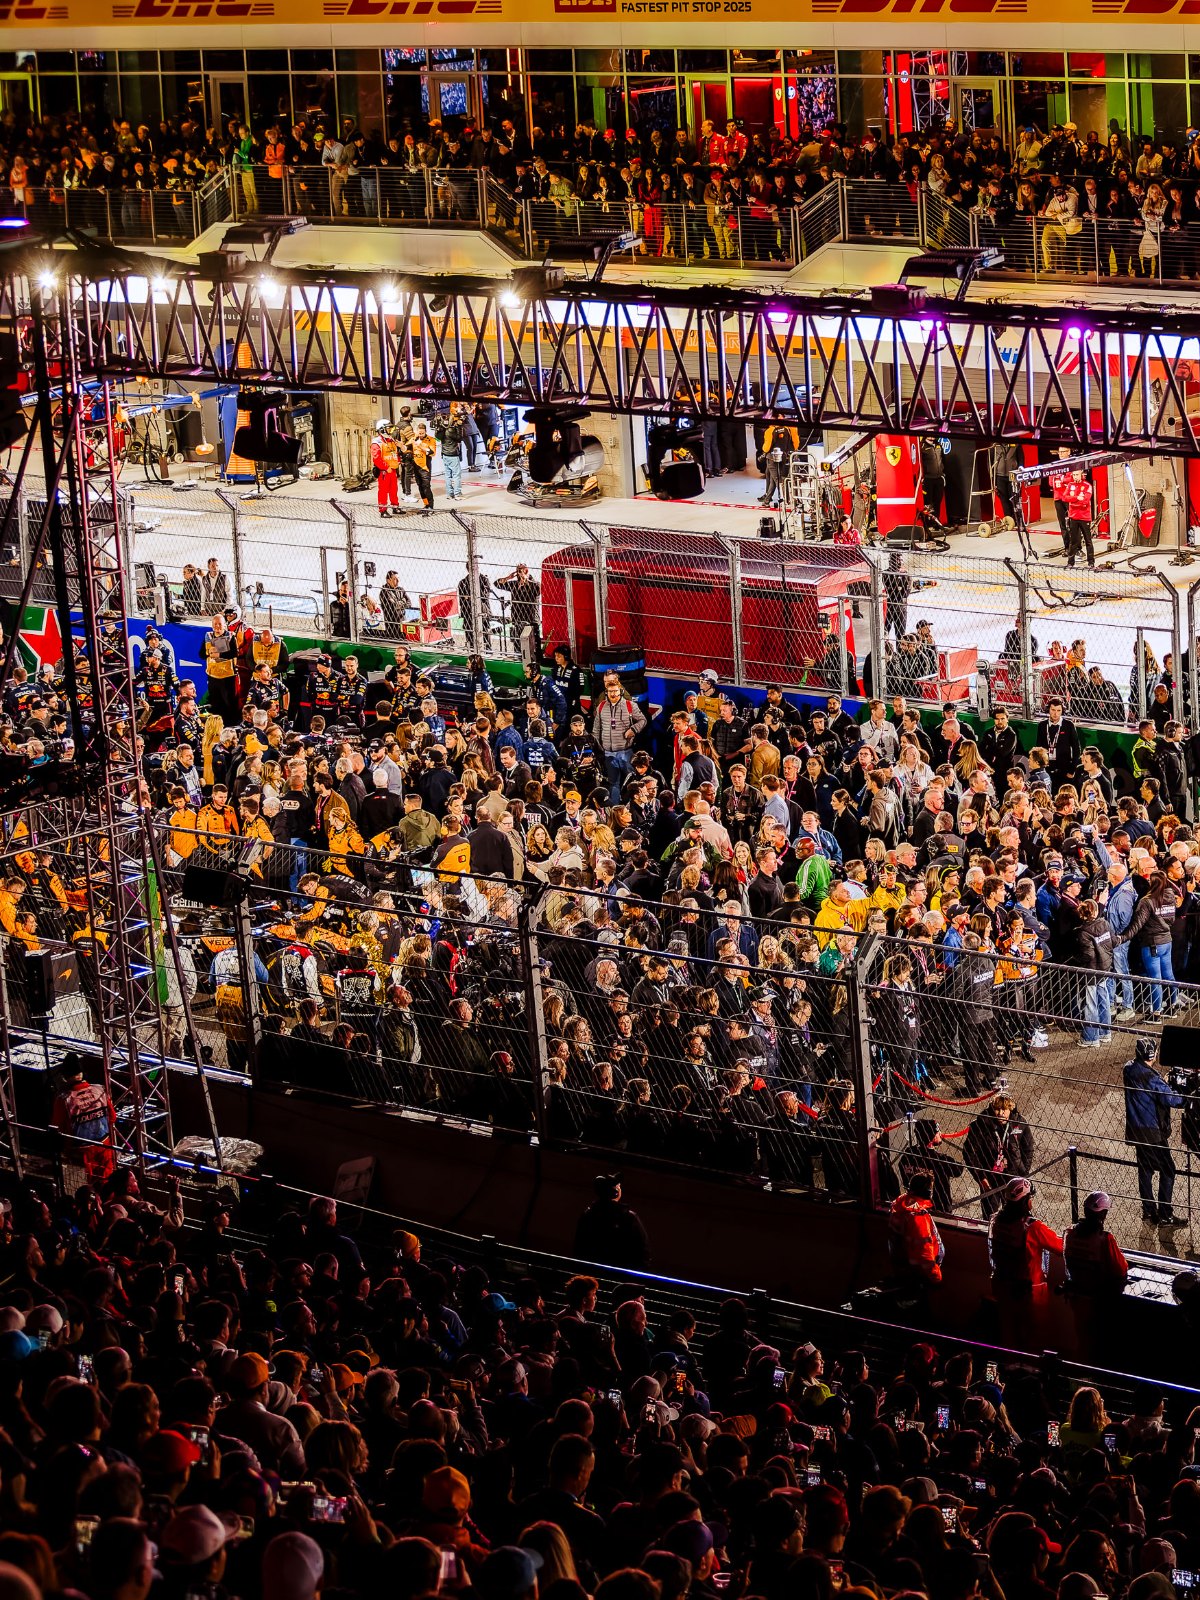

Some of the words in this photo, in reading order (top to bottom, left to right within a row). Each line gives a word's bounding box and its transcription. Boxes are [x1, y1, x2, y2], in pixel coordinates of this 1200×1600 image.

[621, 2, 668, 13] FASTEST
[671, 2, 689, 13] PIT
[692, 2, 722, 13] STOP
[724, 1, 752, 13] 2025
[1042, 466, 1070, 477] LOGISTICS
